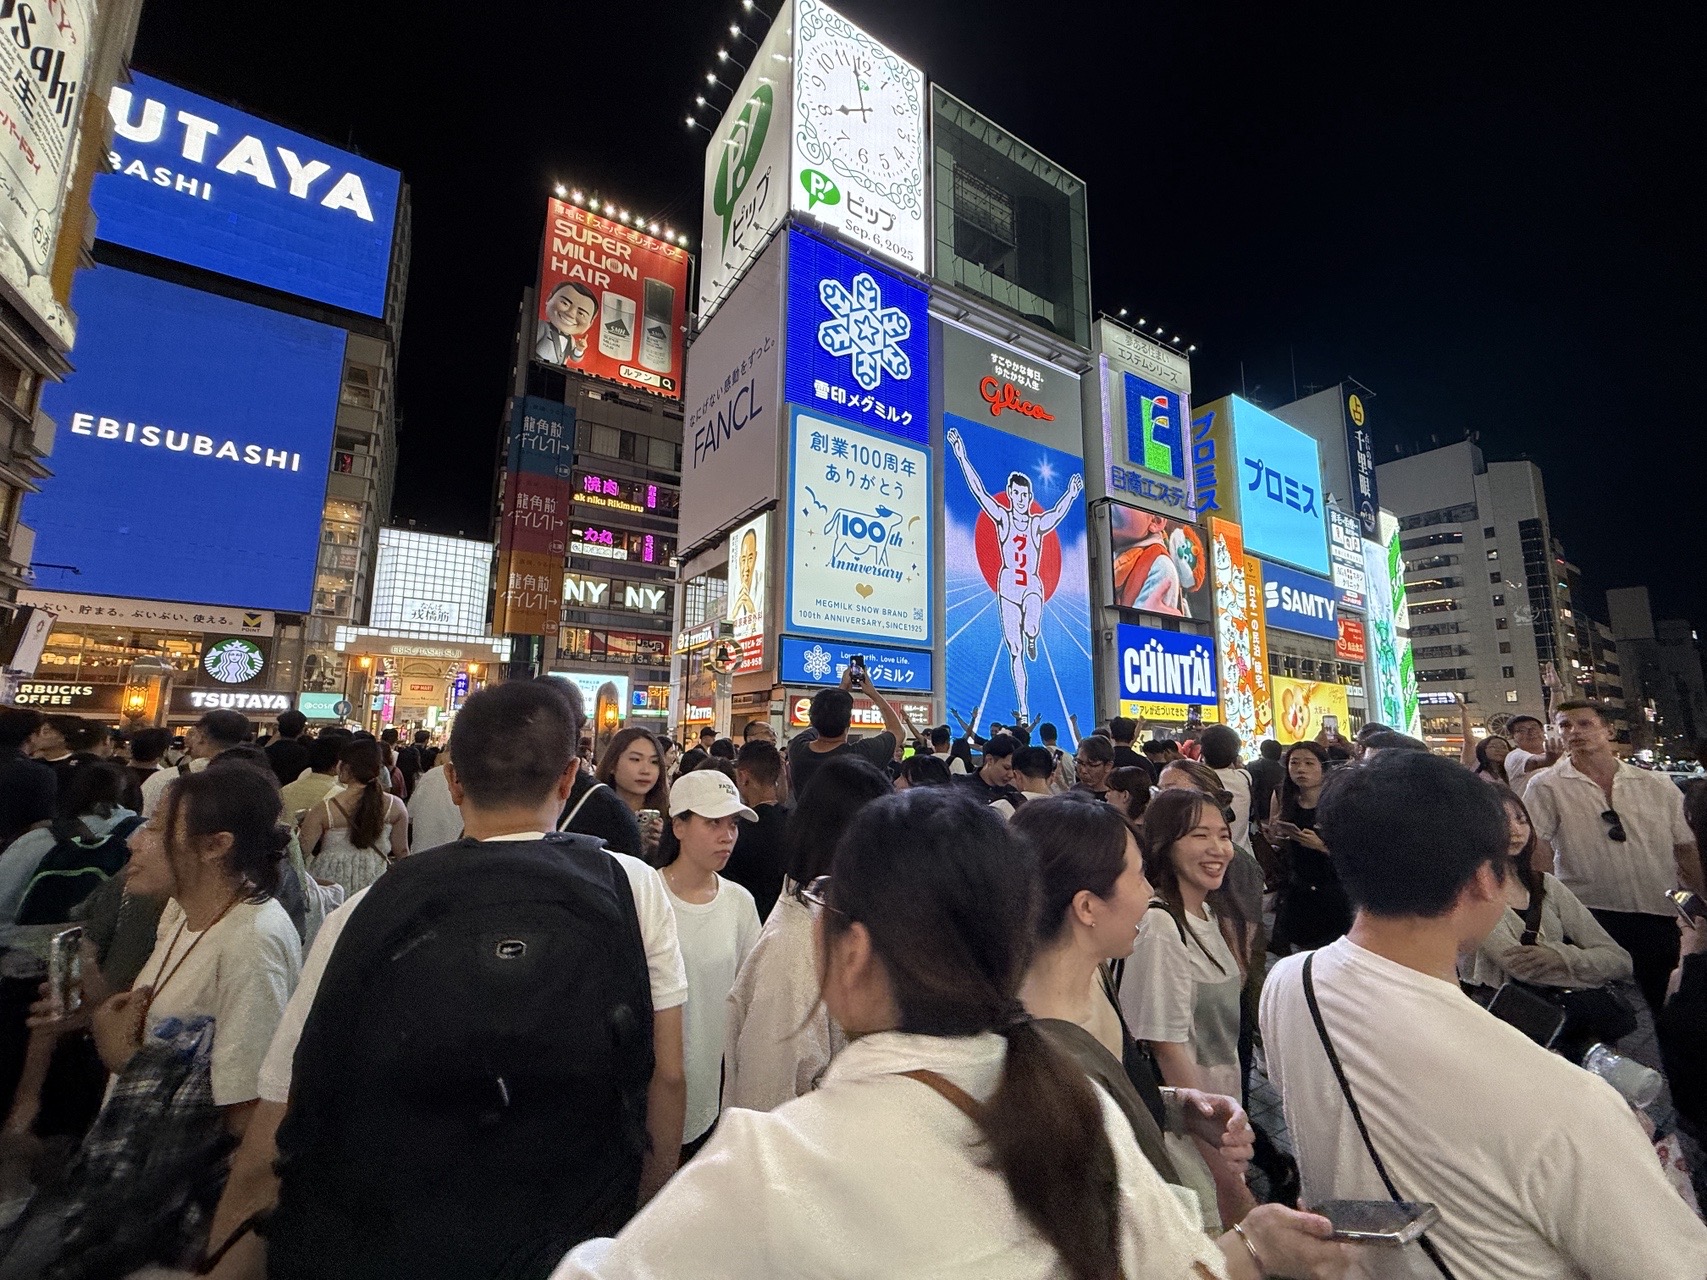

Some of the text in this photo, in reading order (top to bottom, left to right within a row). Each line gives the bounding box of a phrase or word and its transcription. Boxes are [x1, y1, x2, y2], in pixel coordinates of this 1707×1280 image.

[816, 53, 834, 74] 10
[811, 75, 826, 91] 9
[858, 148, 869, 164] 6
[879, 153, 890, 170] 5
[733, 165, 772, 248] ピップ
[847, 191, 897, 232] ピップ
[554, 218, 632, 260] SUPER
[845, 218, 871, 241] Sep.
[885, 239, 914, 262] 2025
[551, 256, 611, 289] HAIR
[553, 237, 638, 281] MILLION
[623, 368, 652, 381] ルアン
[813, 379, 913, 426] 雪印メグミルク
[979, 375, 1056, 421] Glico
[523, 415, 563, 438] 龍角散
[693, 378, 763, 469] FANCL
[71, 412, 301, 472] EBISUBASHI
[810, 431, 917, 478] 創業100周年
[1192, 411, 1221, 514] プロミス
[825, 463, 904, 500] ありがとう
[1244, 457, 1319, 519] プロミス
[516, 492, 557, 514] 龍角散
[825, 556, 904, 583] Anniversary
[1012, 534, 1028, 587] グリコ
[508, 571, 549, 593] 龍角散
[564, 578, 608, 604] NY
[625, 586, 665, 610] NY
[815, 599, 908, 618] MEGMILK SNOW BRAND
[1281, 586, 1335, 621] SAMTY
[799, 610, 821, 620] 100th
[835, 663, 915, 683] 雪メグミルク
[14, 694, 72, 705] OFFEE
[15, 684, 93, 696] RBUCKS
[191, 691, 289, 710] TSUTAYA
